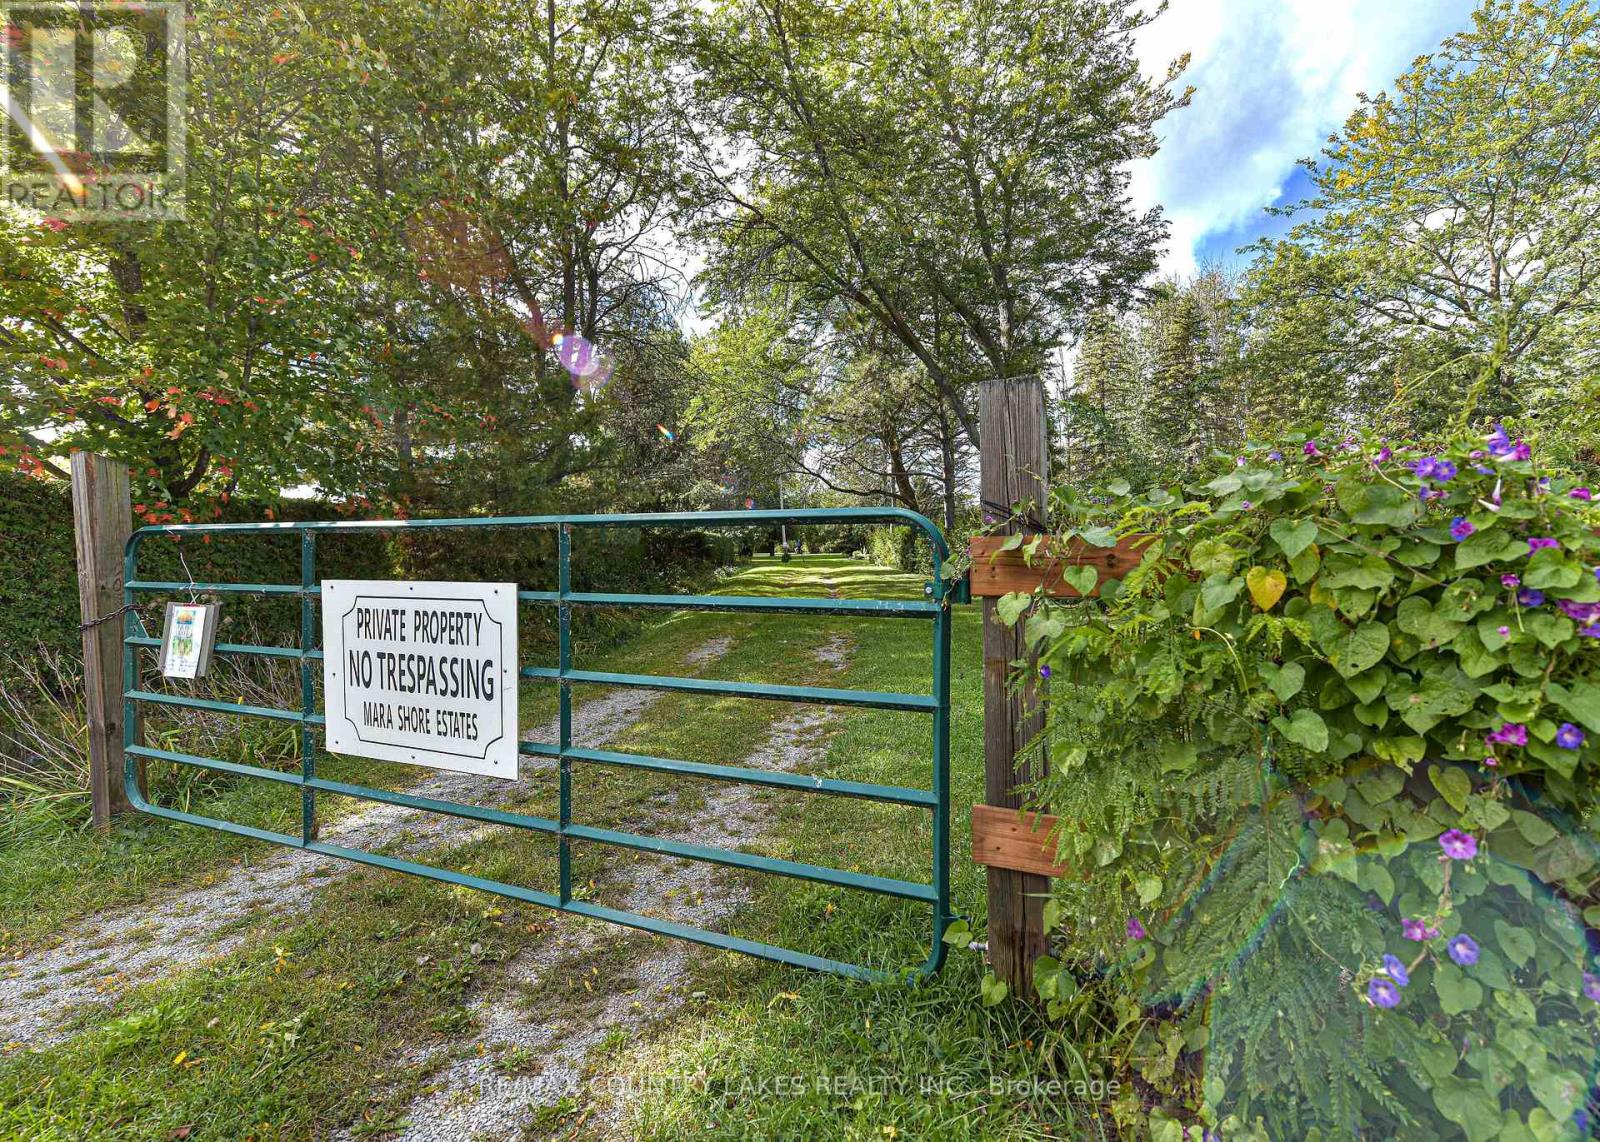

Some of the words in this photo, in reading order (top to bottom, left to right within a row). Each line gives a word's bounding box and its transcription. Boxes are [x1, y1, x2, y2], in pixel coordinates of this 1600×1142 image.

[356, 607, 406, 642] PRIVATE
[413, 611, 482, 646] PROPERTY
[349, 650, 372, 689] NO
[376, 651, 495, 701] TRESPASSING
[363, 701, 394, 730] MARA
[398, 705, 431, 735] SHORE
[436, 709, 478, 742] ESTATES
